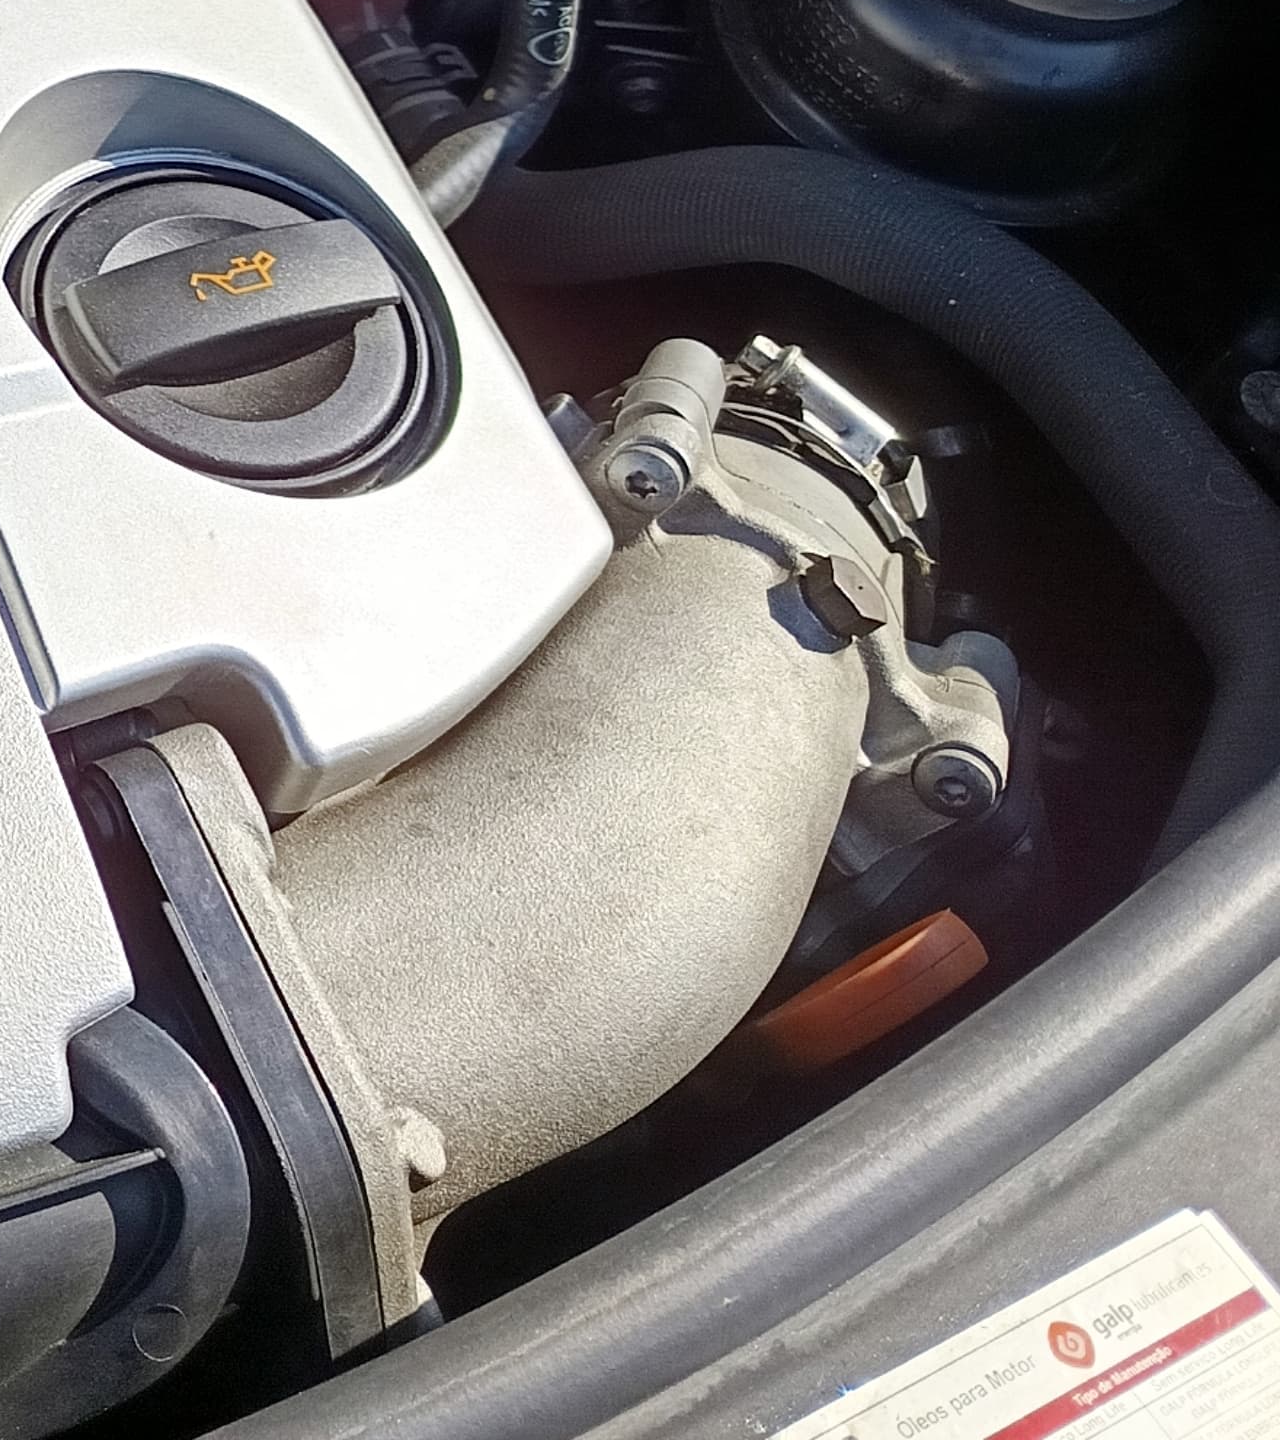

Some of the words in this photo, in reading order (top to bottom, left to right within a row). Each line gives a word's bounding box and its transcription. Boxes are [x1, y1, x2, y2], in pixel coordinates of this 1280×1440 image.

[1093, 1303, 1133, 1339] galp
[896, 1405, 949, 1439] Óleos
[950, 1384, 988, 1416] para
[985, 1355, 1038, 1390] Motor
[1072, 1389, 1099, 1406] Tipo
[1098, 1381, 1114, 1394] de
[1075, 1412, 1105, 1433] Long
[1103, 1401, 1125, 1419] Life
